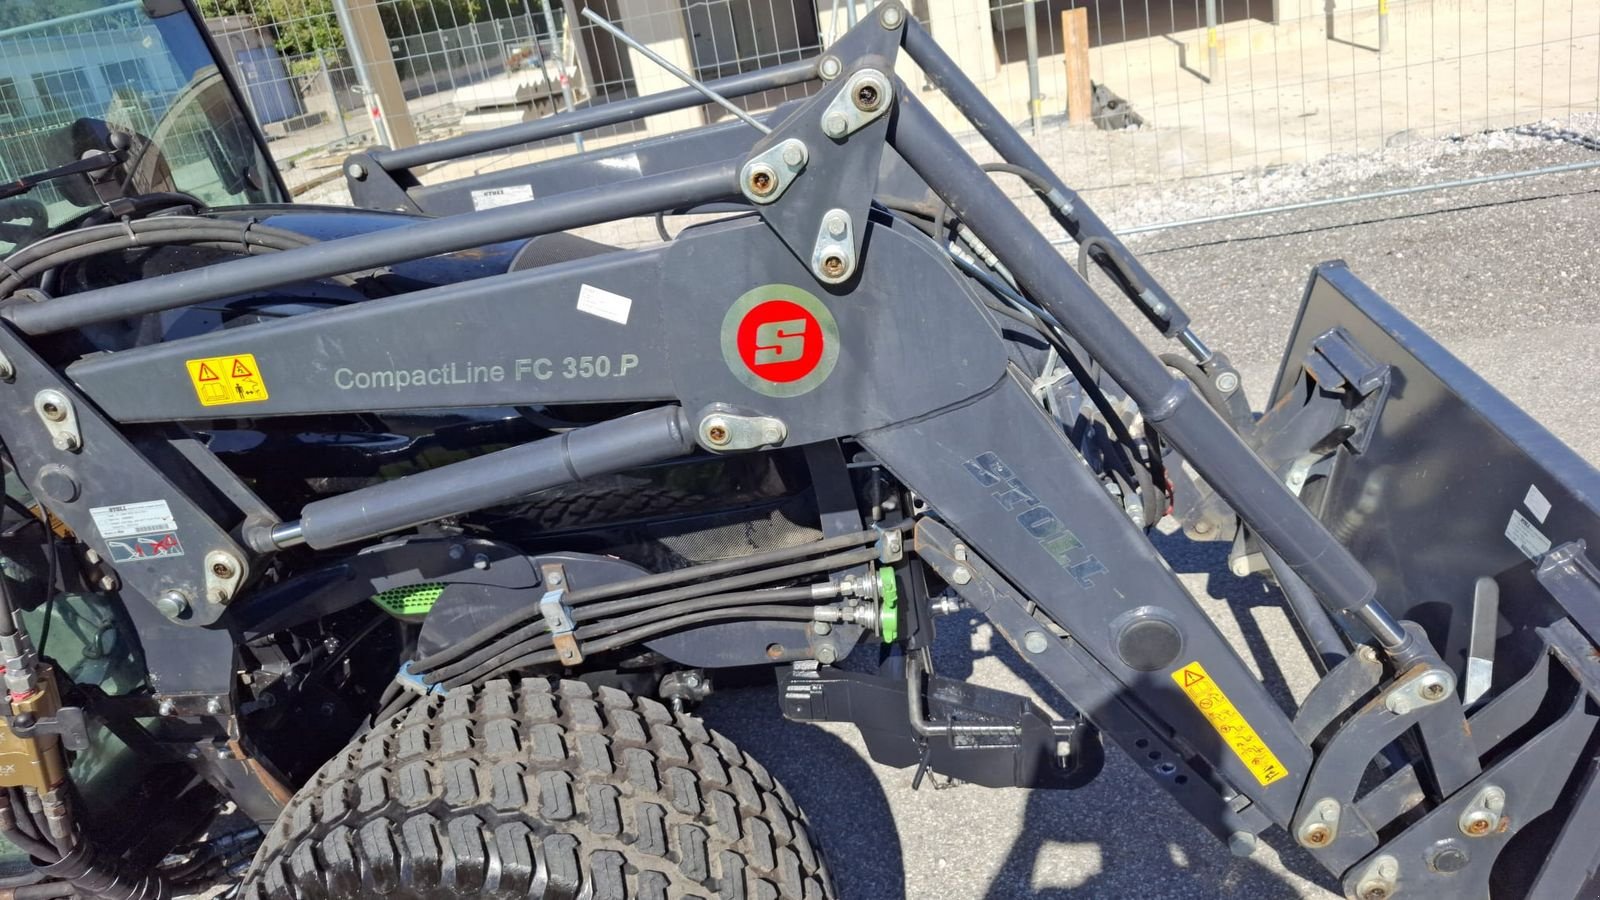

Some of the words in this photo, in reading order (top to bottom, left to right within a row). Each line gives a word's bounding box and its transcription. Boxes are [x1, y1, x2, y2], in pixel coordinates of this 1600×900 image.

[334, 361, 505, 391] CompactLine
[515, 358, 553, 381] FC
[562, 355, 611, 379] 350
[961, 450, 1109, 590] STOLL
